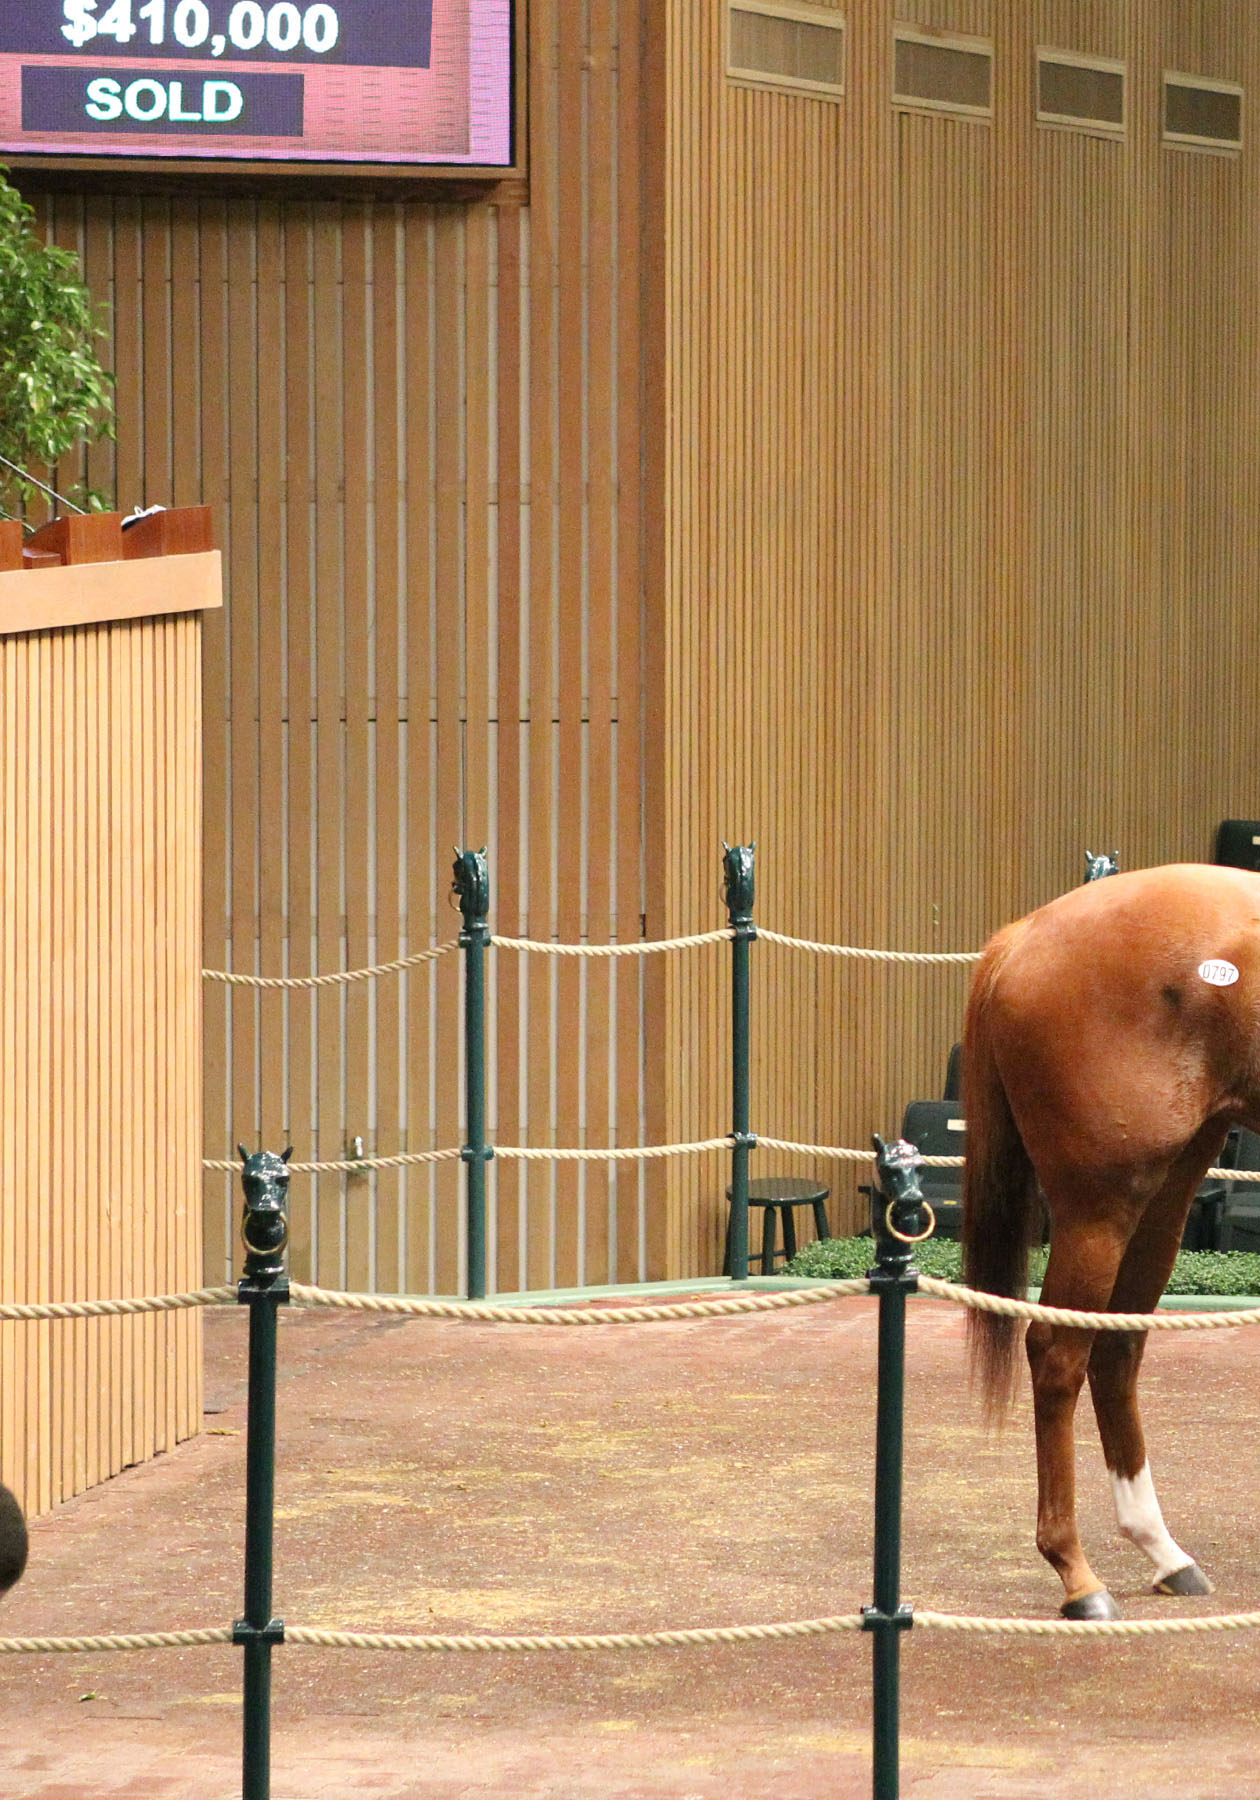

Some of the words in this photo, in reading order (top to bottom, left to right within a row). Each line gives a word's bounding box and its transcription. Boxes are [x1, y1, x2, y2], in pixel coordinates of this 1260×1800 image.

[60, 0, 339, 56] $410,000
[84, 77, 244, 122] SOLD
[1203, 964, 1235, 982] 0797
